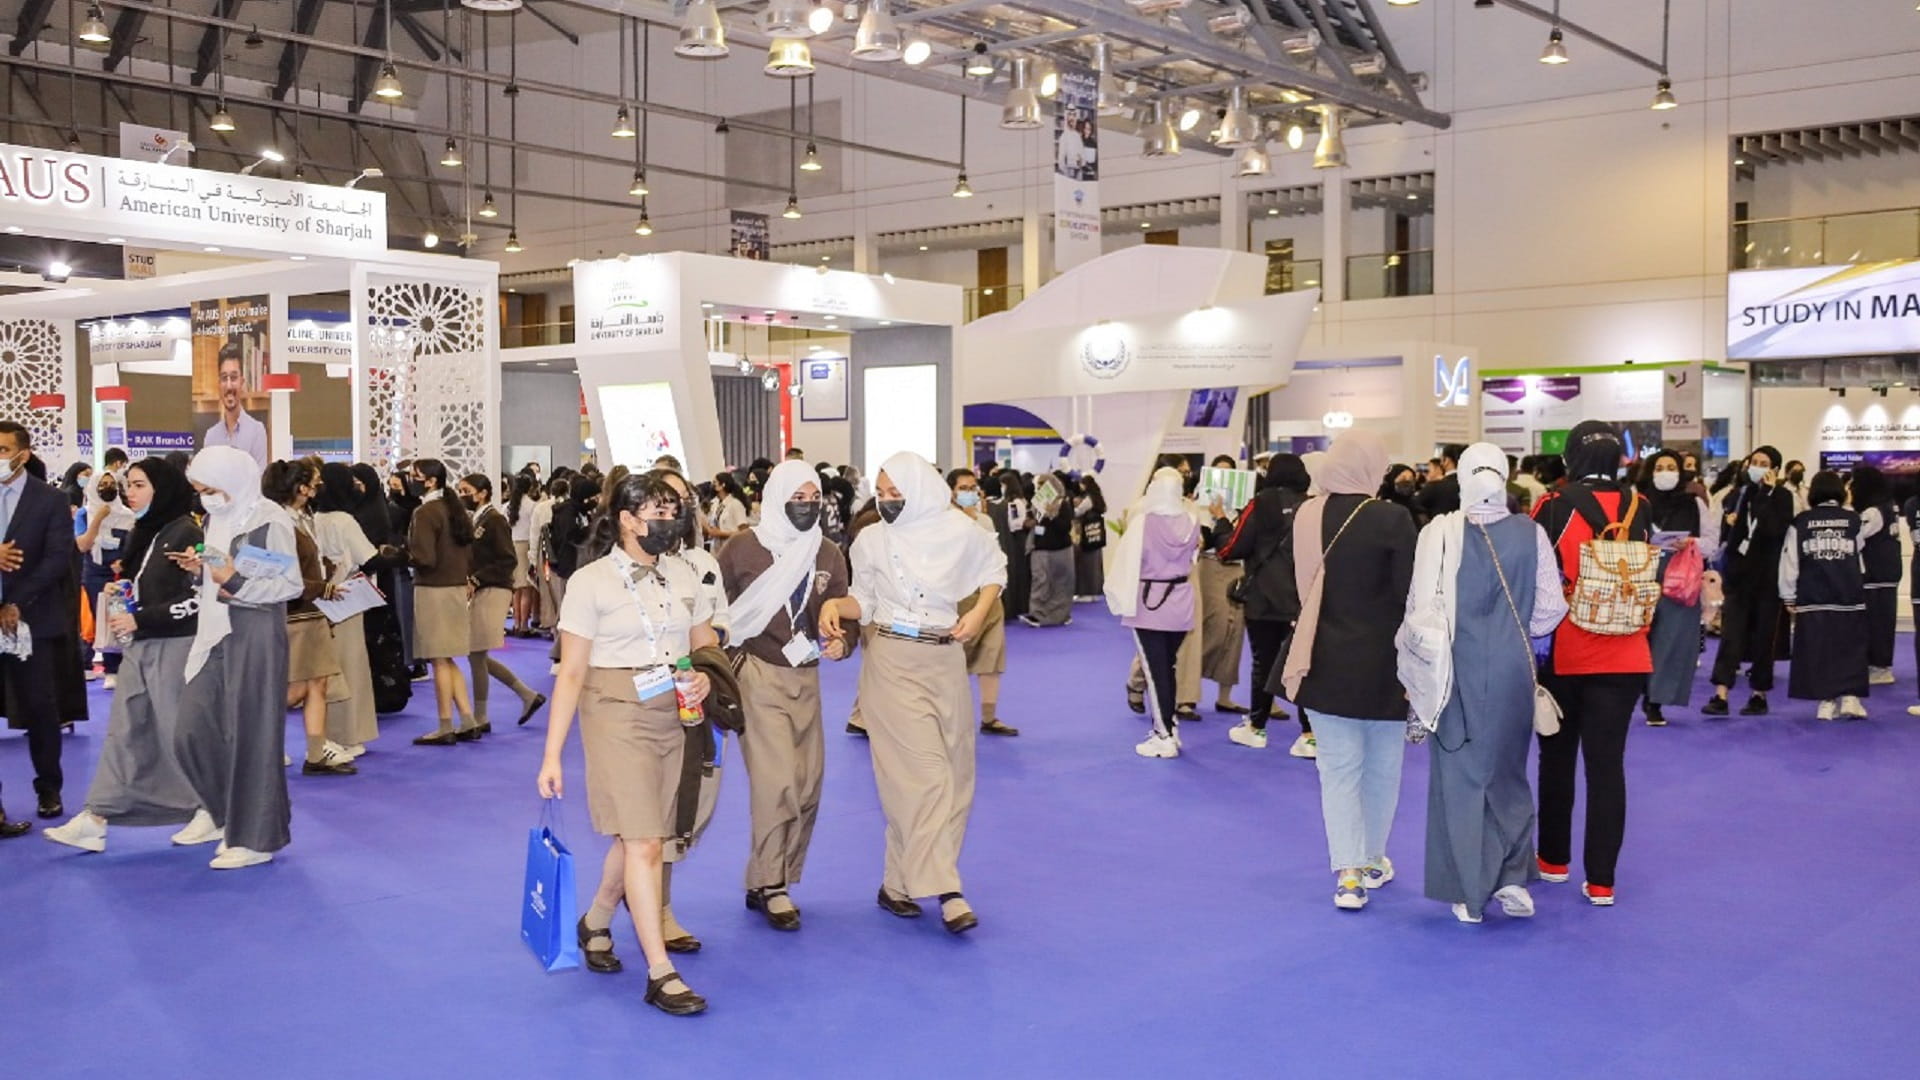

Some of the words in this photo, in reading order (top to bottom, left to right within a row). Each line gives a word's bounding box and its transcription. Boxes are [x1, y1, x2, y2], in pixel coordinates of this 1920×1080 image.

[118, 169, 194, 192] الشارقة
[198, 183, 222, 204] في
[308, 195, 372, 216] الجامعة
[120, 195, 202, 220] American
[208, 205, 289, 233] University
[295, 216, 312, 233] of
[316, 218, 372, 241] Sharjah
[1742, 301, 1828, 327] STUDY
[1836, 300, 1861, 321] IN
[1870, 293, 1920, 320] MA
[1666, 414, 1689, 425] 70%
[134, 436, 153, 444] RAK
[156, 436, 186, 445] Branch
